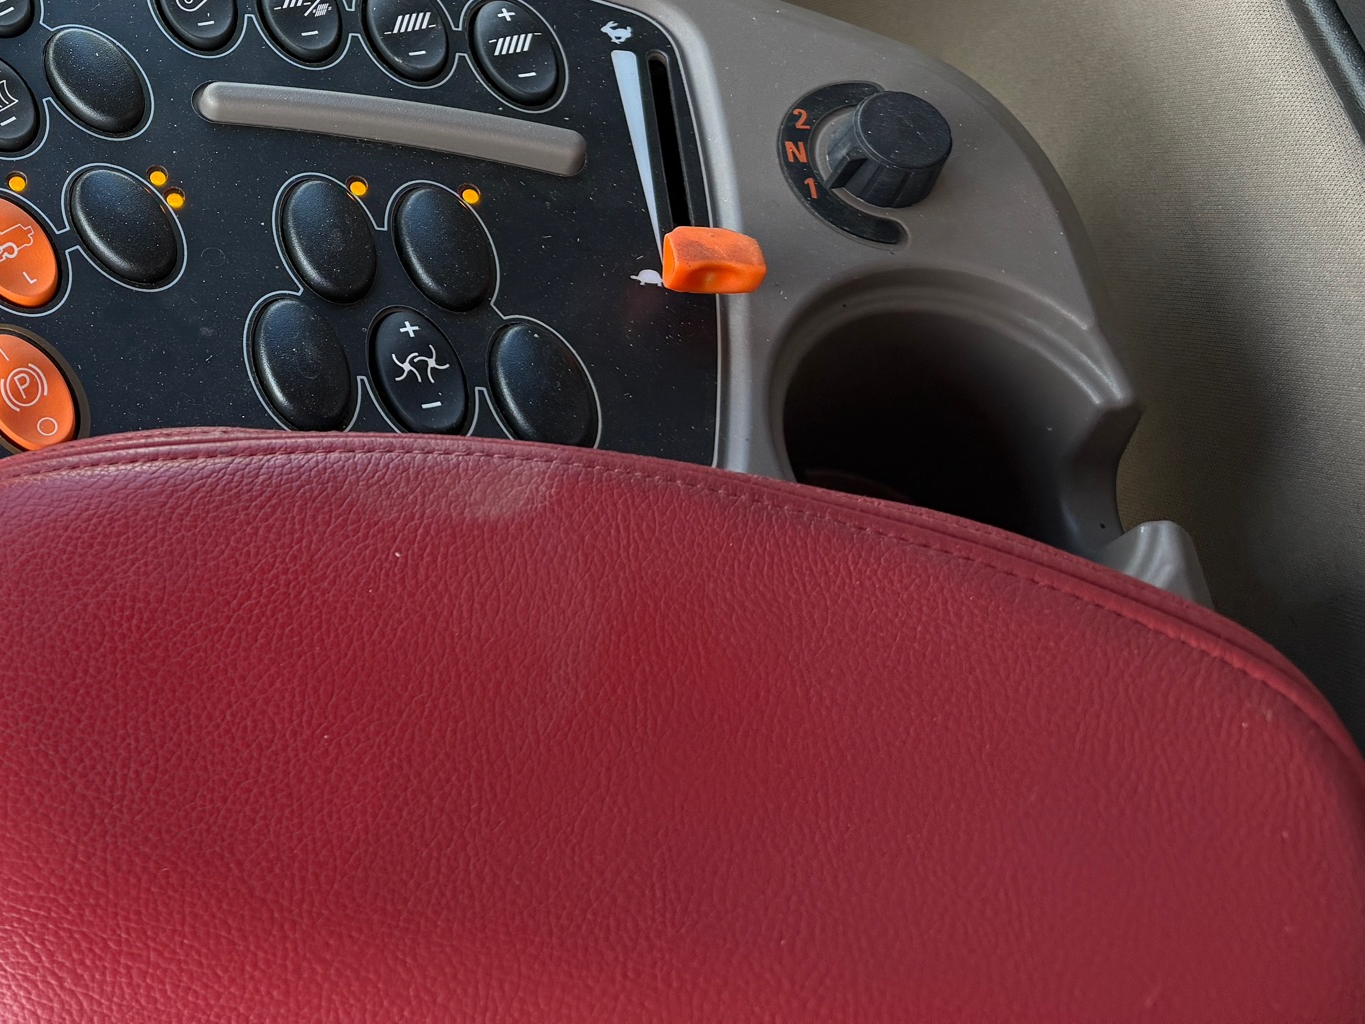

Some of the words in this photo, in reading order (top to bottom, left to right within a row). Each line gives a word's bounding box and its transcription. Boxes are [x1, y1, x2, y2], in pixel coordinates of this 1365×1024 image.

[792, 108, 811, 130] 2
[784, 140, 808, 163] N
[804, 177, 818, 199] 1
[22, 271, 38, 285] L
[14, 373, 31, 399] P
